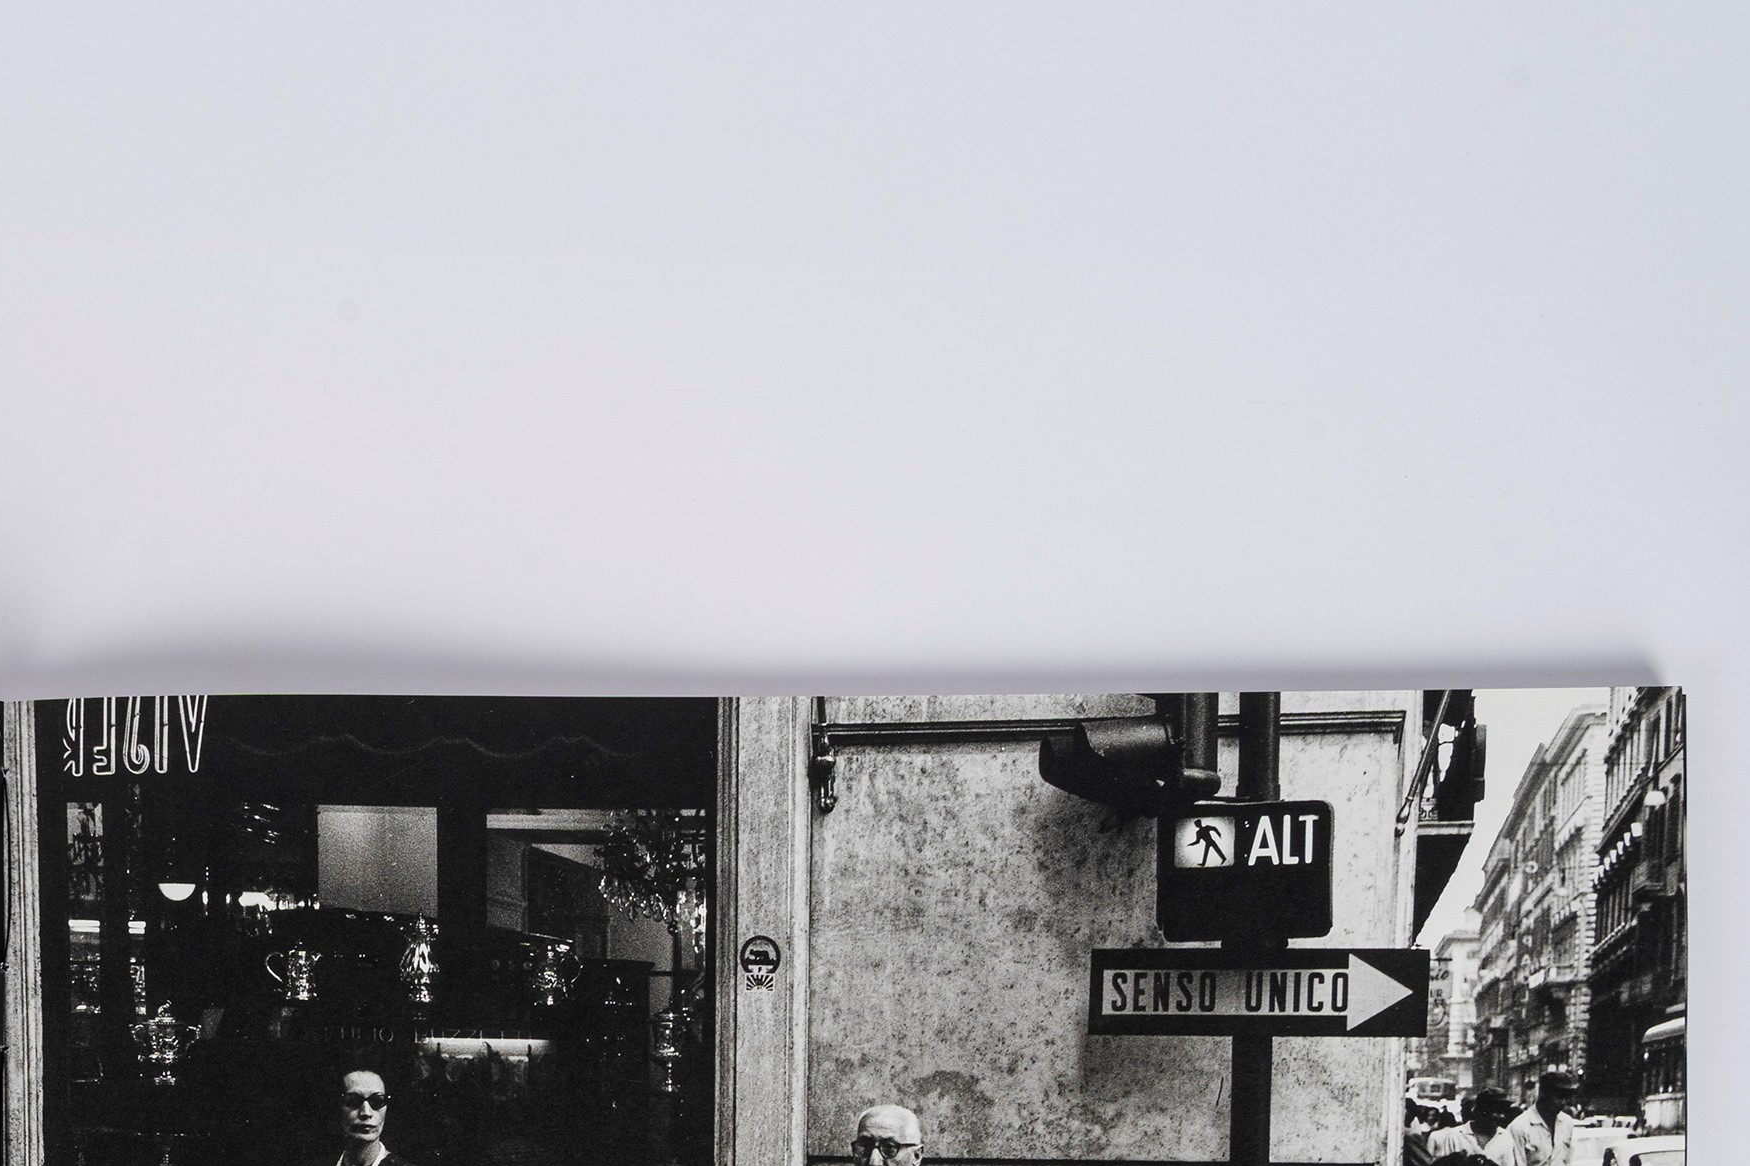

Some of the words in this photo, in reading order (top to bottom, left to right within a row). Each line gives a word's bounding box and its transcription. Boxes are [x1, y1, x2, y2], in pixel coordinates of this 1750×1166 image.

[1248, 814, 1319, 866] ALT
[1111, 972, 1217, 1013] SENSO
[1245, 972, 1349, 1013] UNICO
